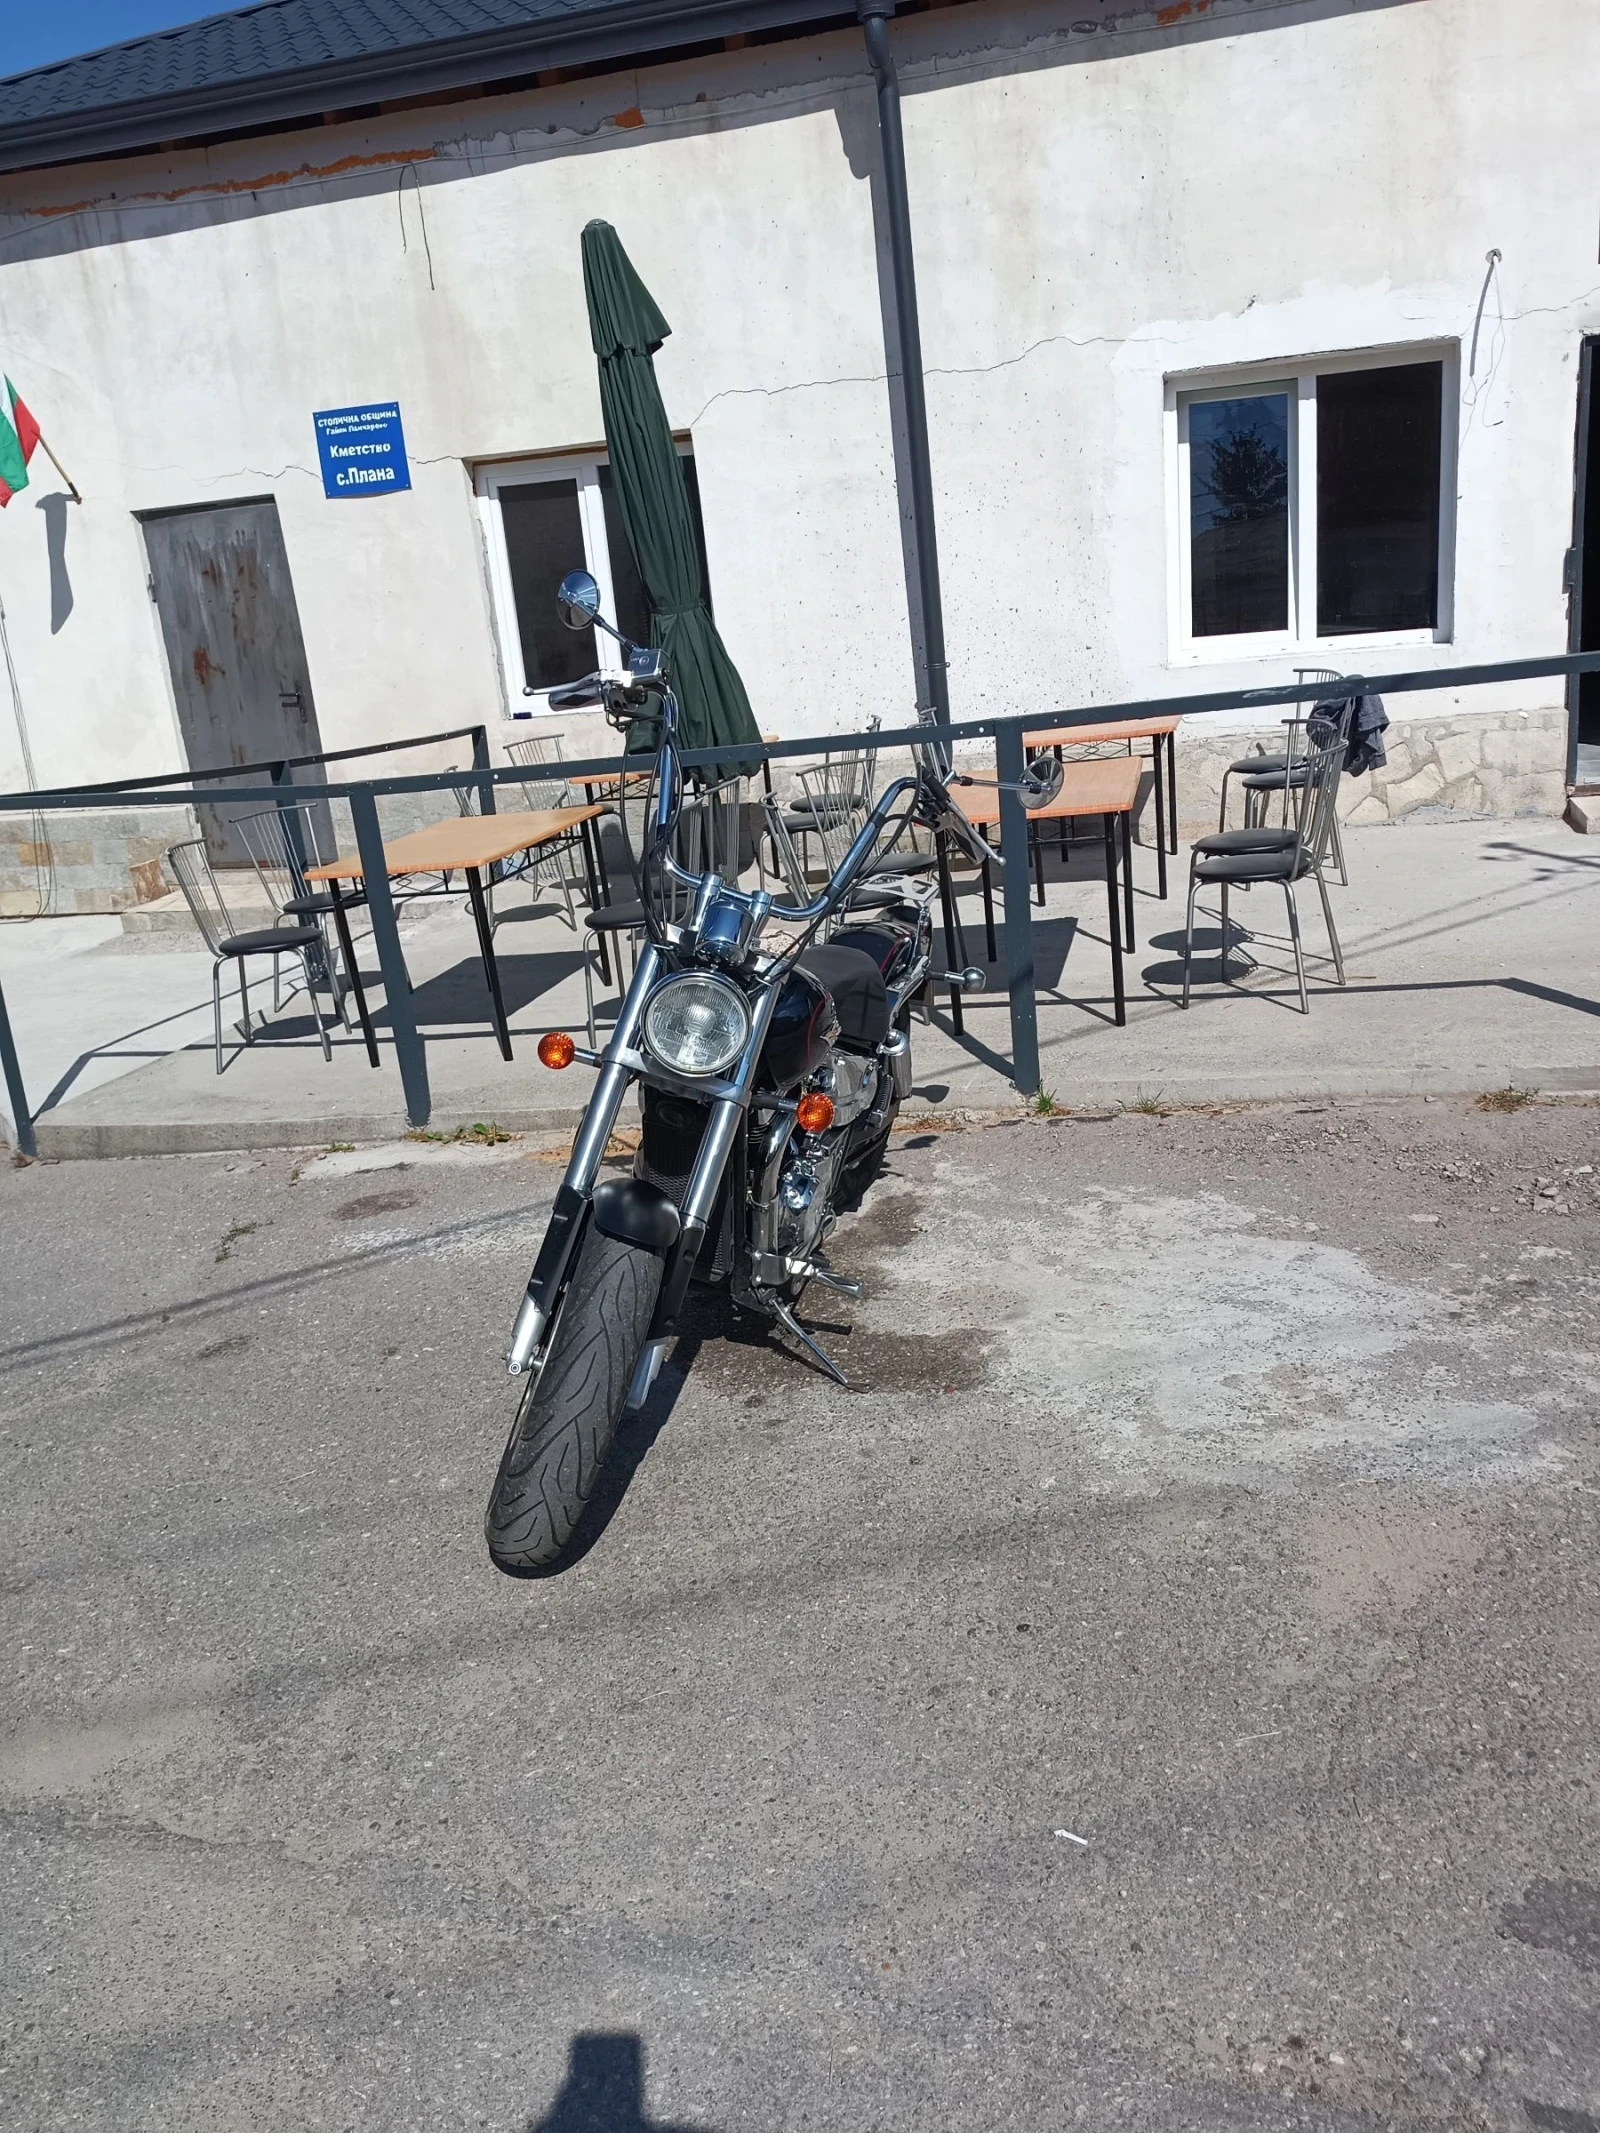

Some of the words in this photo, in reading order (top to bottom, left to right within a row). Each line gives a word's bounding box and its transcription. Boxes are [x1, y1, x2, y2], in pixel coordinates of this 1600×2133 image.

[318, 415, 359, 427] СТОЛИЧНА
[360, 411, 397, 421] ОБЩИНА
[329, 443, 391, 458] Кметство
[336, 467, 395, 486] с.Плана
